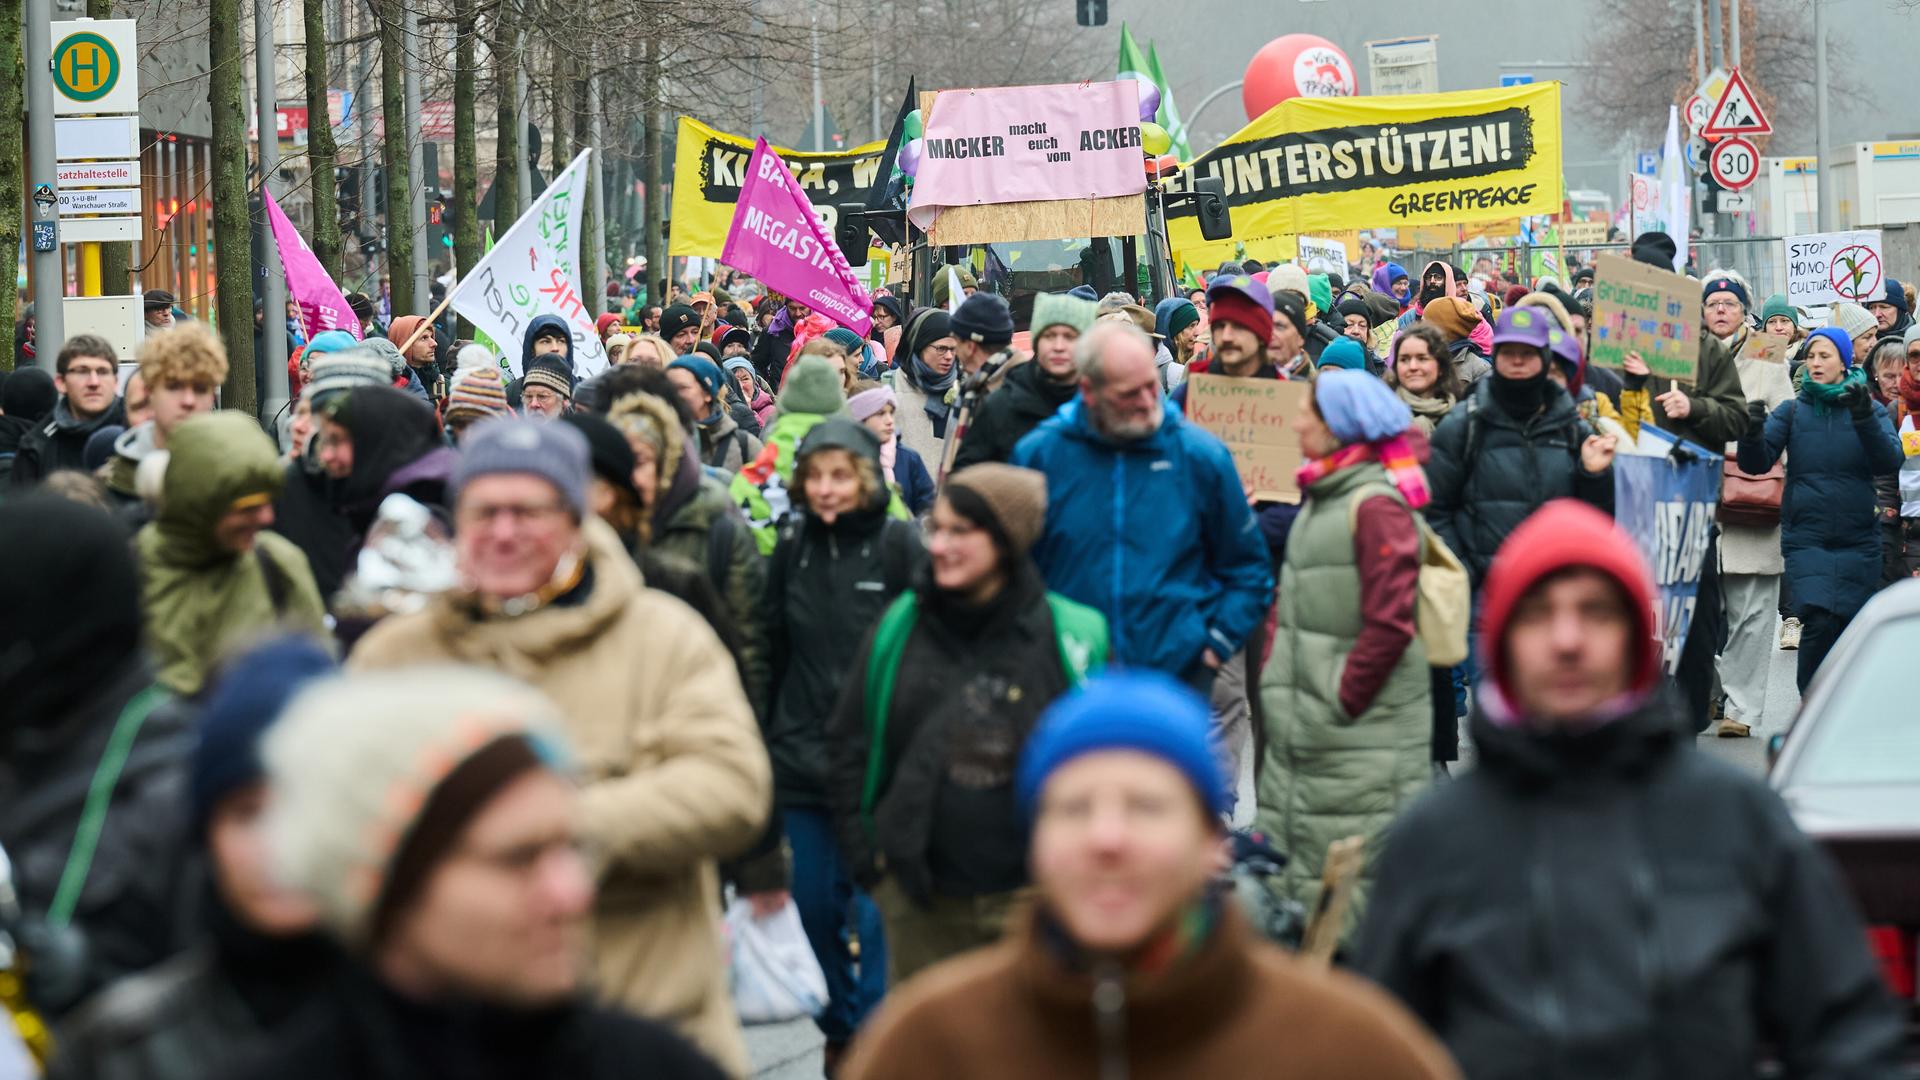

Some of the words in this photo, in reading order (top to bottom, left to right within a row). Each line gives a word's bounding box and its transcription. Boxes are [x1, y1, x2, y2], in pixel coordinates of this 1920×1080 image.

[71, 48, 100, 87] H
[1009, 121, 1047, 136] macht
[926, 136, 1005, 160] MACKER
[1028, 136, 1058, 151] euch
[1079, 126, 1142, 152] ACKER
[1046, 151, 1071, 163] vom
[1208, 121, 1512, 197] UNTERSTÜTZEN!
[1721, 152, 1750, 175] 30
[57, 168, 128, 180] satzhaltestelle
[59, 196, 70, 205] 00
[108, 201, 128, 209] Straße
[1389, 183, 1538, 219] GREENPEACE
[1790, 241, 1828, 258] STOP
[1790, 260, 1830, 278] MONO-
[1789, 278, 1835, 295] CULTURE
[1196, 377, 1277, 398] Krumme
[1191, 400, 1284, 428] Karotten
